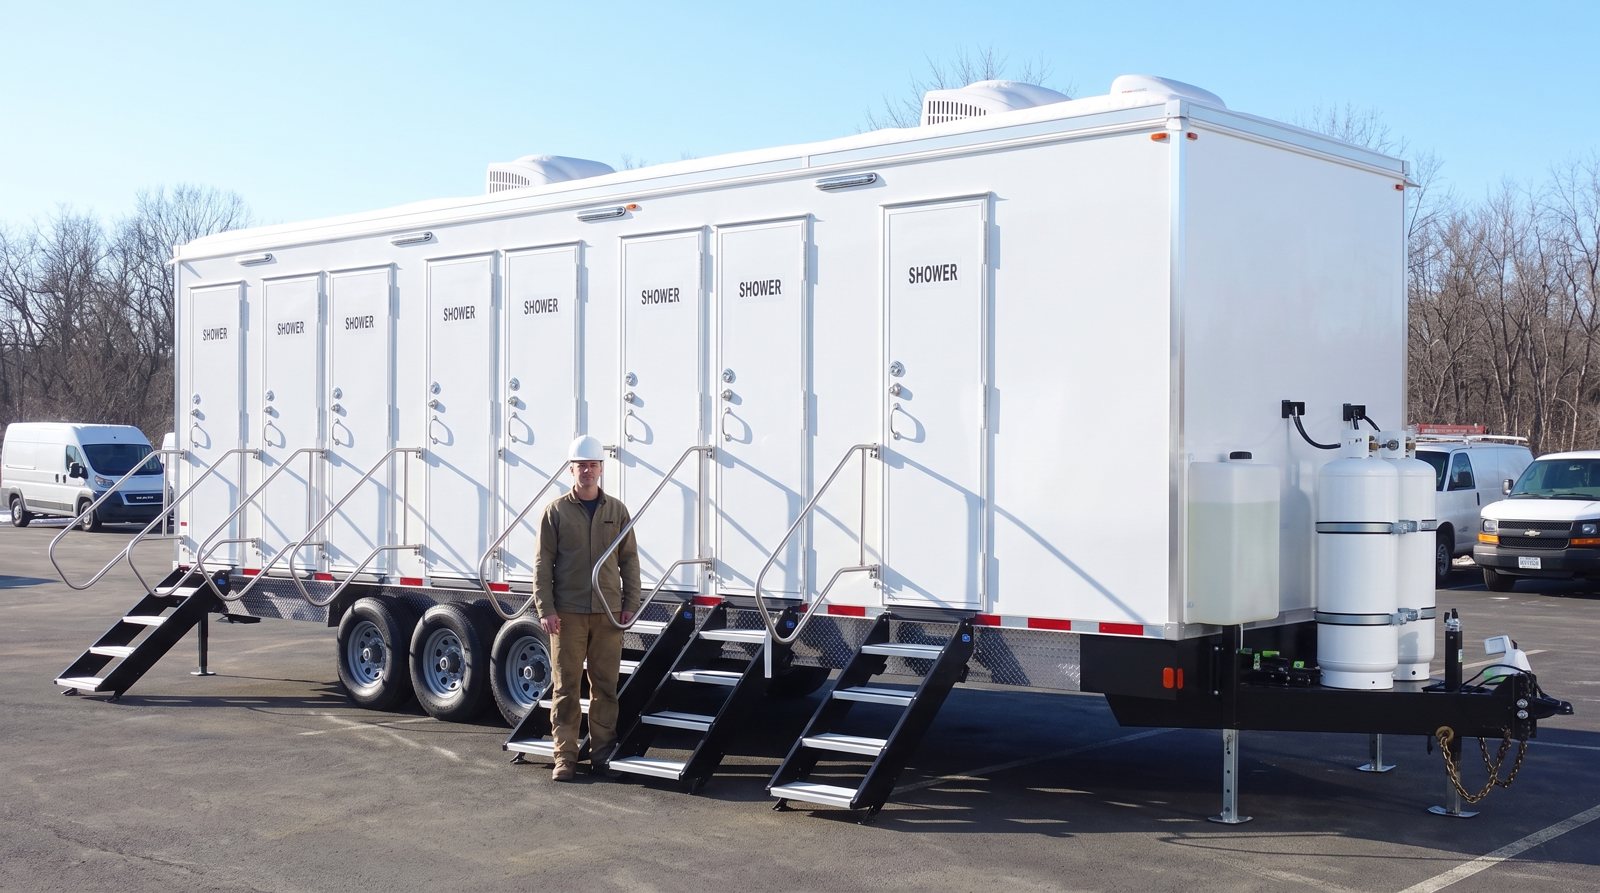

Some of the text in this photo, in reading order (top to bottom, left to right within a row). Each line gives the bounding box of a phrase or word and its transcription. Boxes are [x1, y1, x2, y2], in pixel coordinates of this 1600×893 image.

[908, 263, 958, 284] SHOWER
[641, 287, 680, 305] SHOWER
[739, 279, 782, 298] SHOWER
[443, 305, 476, 322] SHOWER
[524, 298, 558, 315] SHOWER
[277, 321, 304, 336] SHOWER
[345, 315, 374, 330] SHOWER
[203, 327, 227, 341] SHOWER
